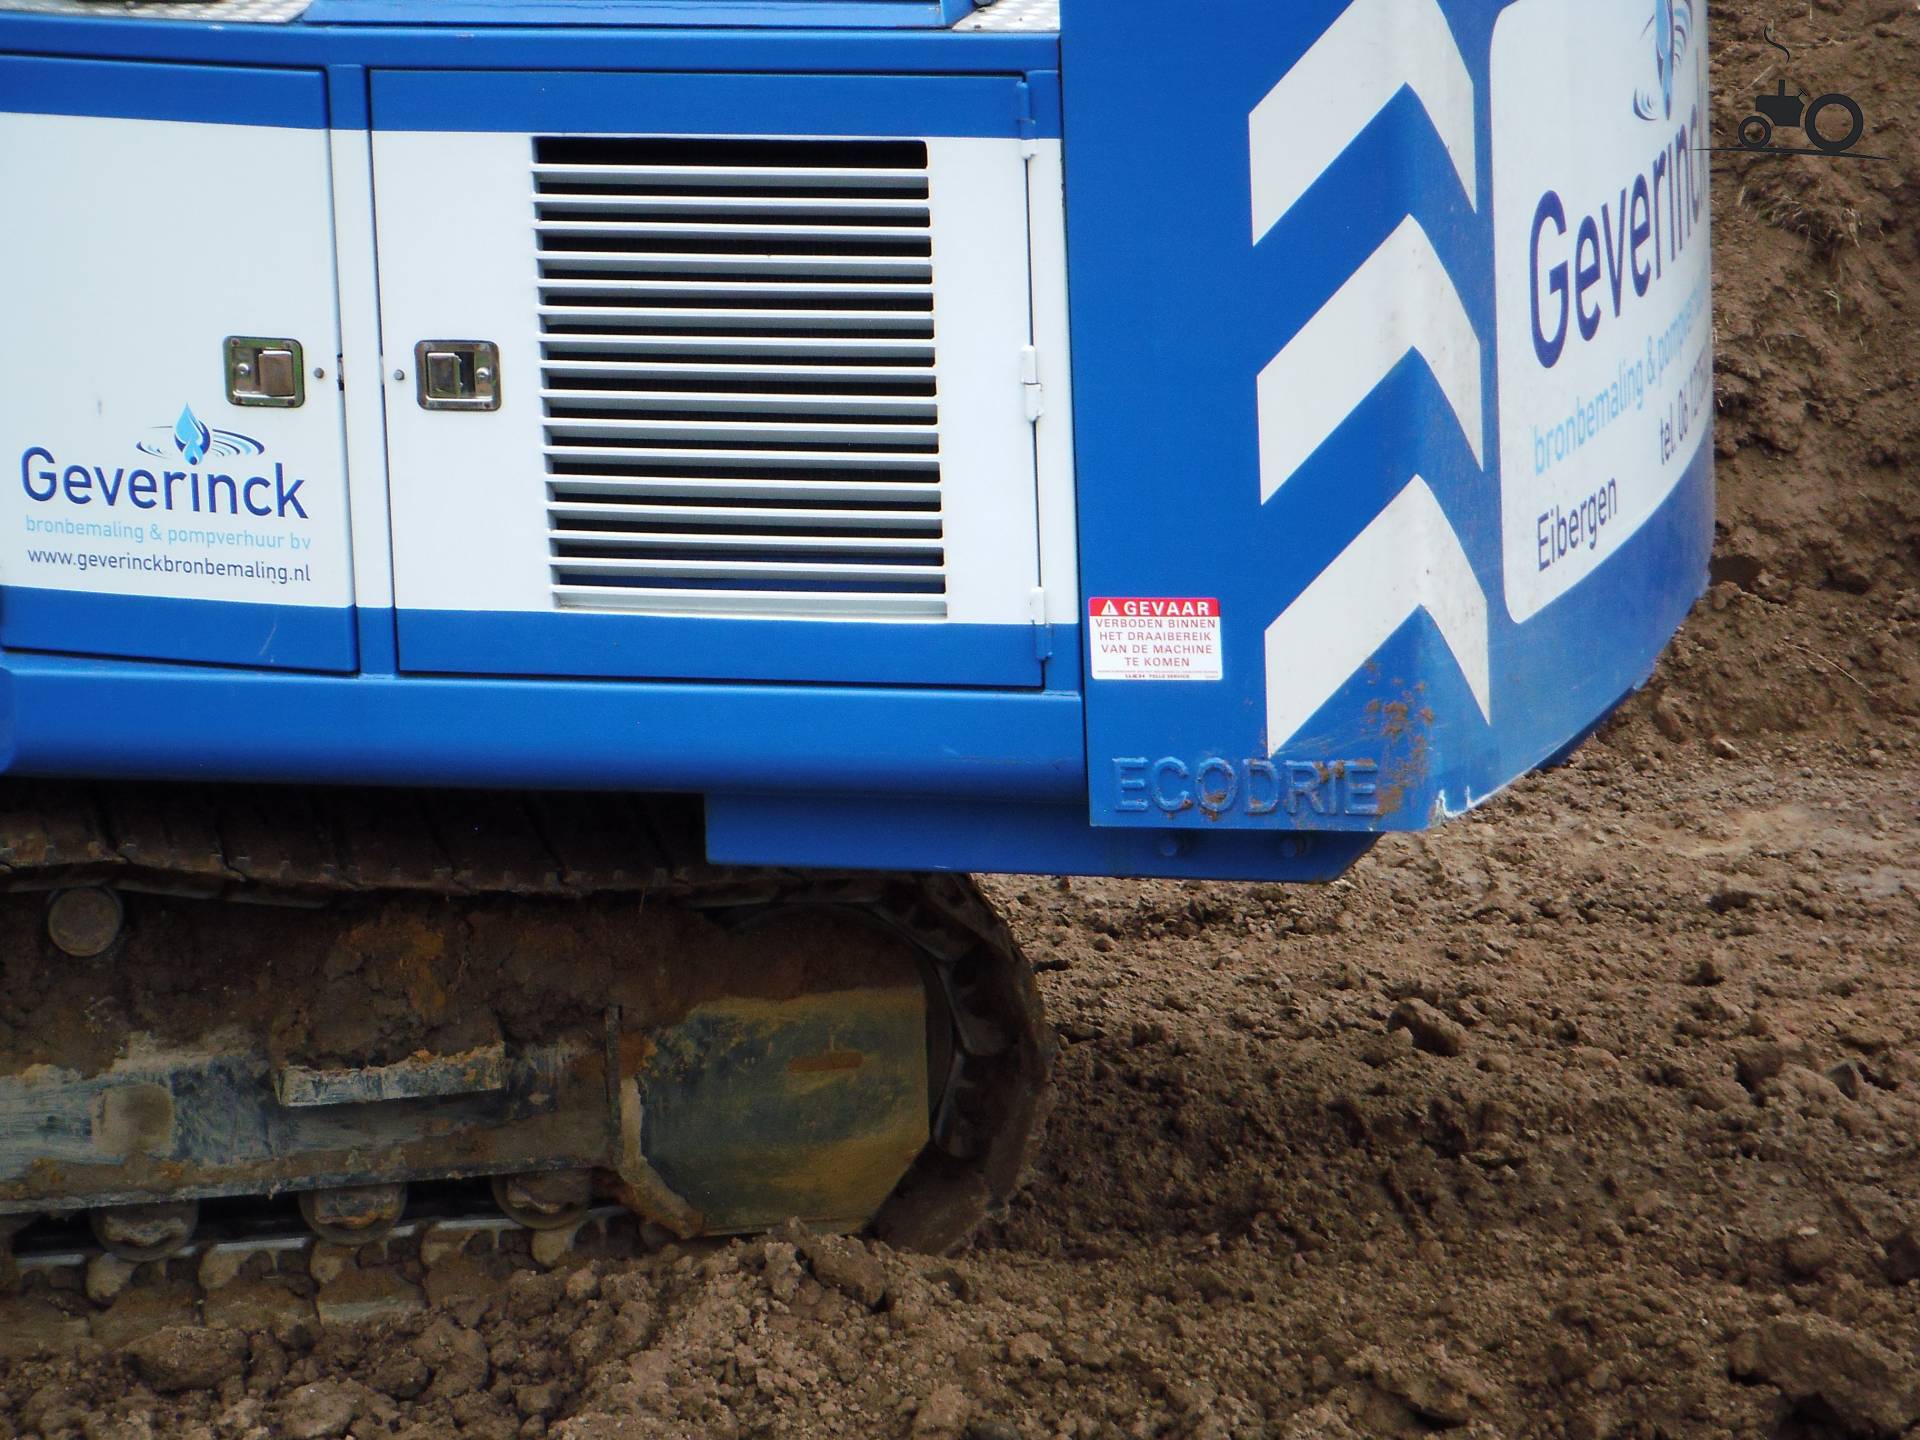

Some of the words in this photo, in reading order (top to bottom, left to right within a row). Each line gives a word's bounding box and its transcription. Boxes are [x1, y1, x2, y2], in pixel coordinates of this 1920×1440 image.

[1533, 357, 1643, 476] bronbemaling
[1647, 335, 1656, 385] &
[20, 446, 309, 519] Geverinck
[26, 515, 145, 543] bronbemaling
[150, 523, 162, 541] &
[168, 526, 285, 549] pompverhuur
[290, 532, 311, 550] bv
[1537, 477, 1617, 572] Eibergen
[27, 549, 311, 585] www.geverinckbronbemaling.nl
[1096, 619, 1163, 629] VERBODEN
[1168, 619, 1216, 629] BINNEN
[1123, 601, 1209, 616] GEVAAR
[1099, 631, 1123, 641] HET
[1127, 631, 1212, 641] DRAAIBEREIK
[1101, 644, 1127, 654] VAN
[1132, 644, 1148, 654] DE
[1153, 644, 1213, 654] MACHINE
[1125, 656, 1140, 667] TE
[1144, 656, 1190, 667] KOMEN
[1112, 756, 1378, 815] ECODRIE
